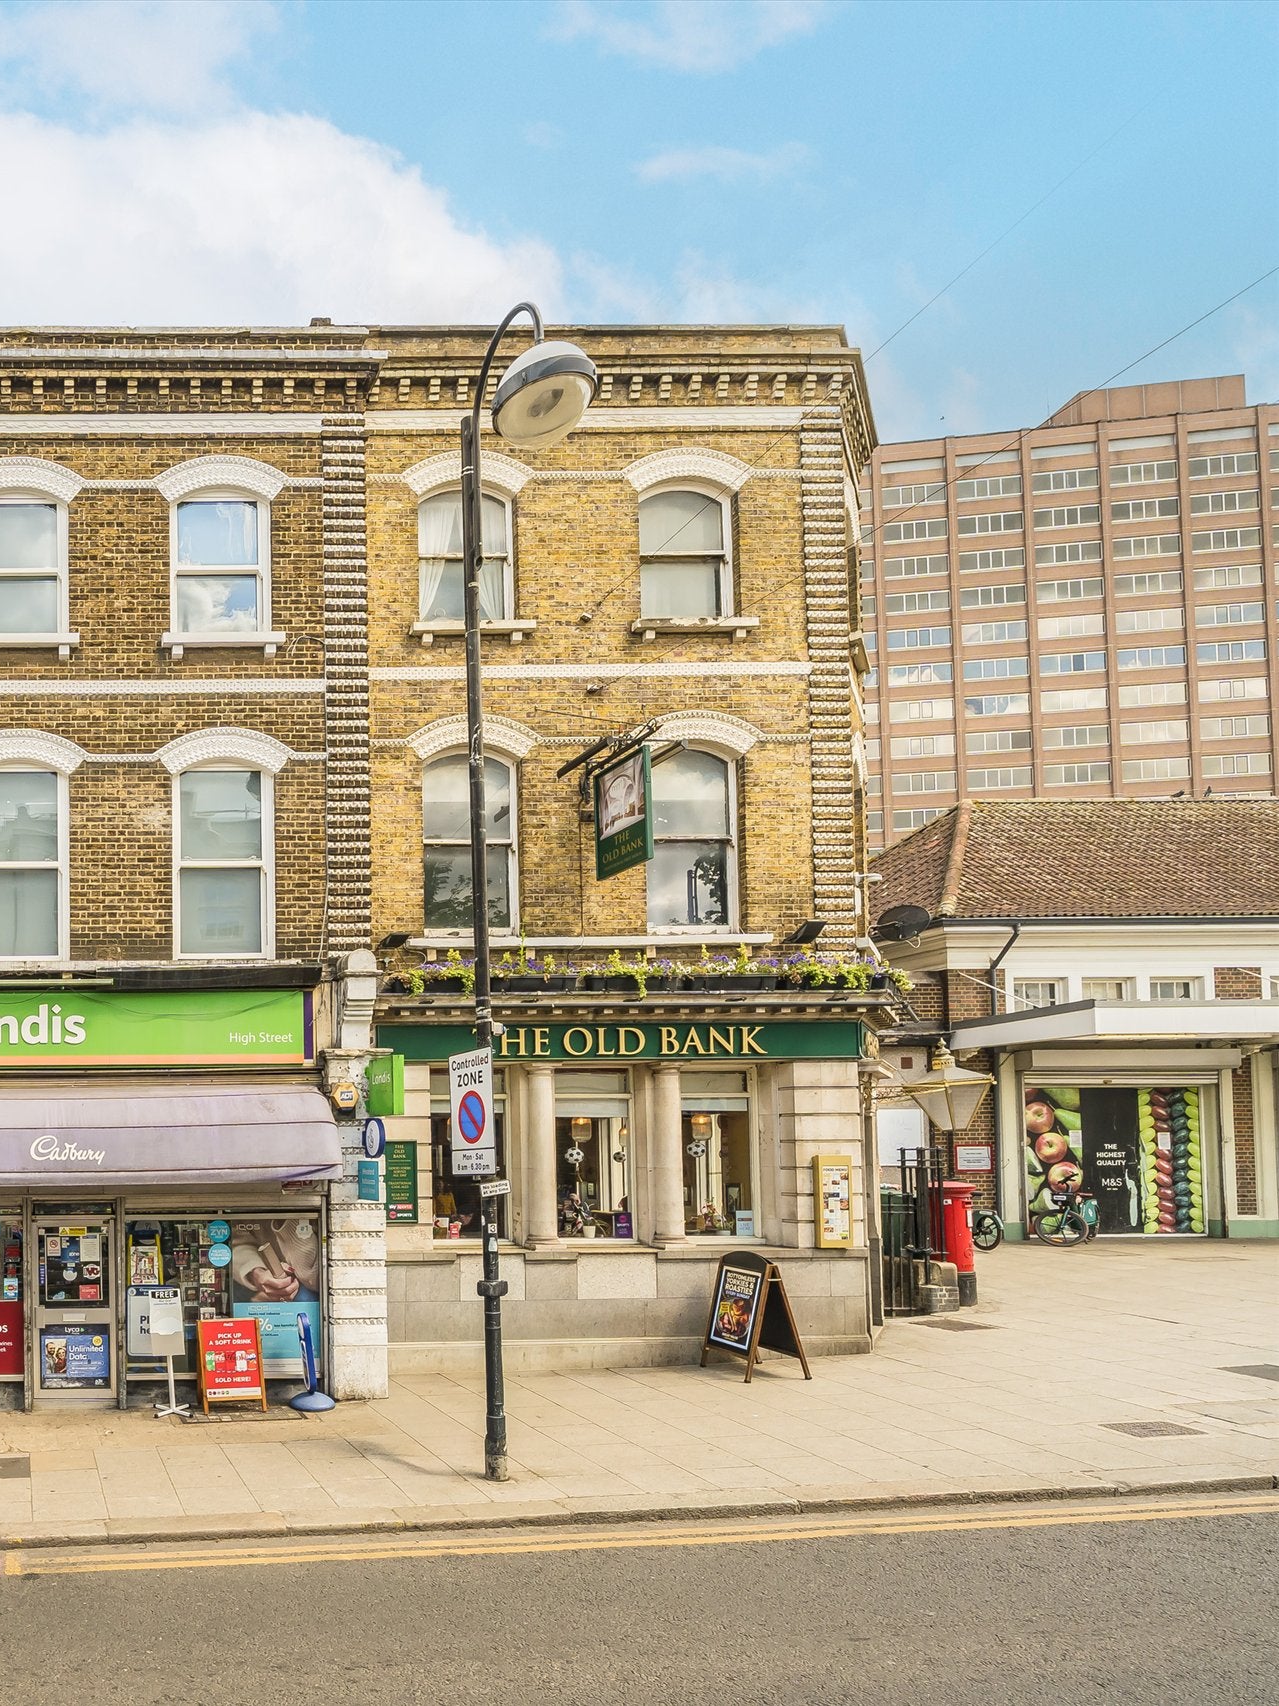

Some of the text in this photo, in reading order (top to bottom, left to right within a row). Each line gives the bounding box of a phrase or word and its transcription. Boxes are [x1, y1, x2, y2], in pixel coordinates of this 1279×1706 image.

[614, 830, 629, 845] THE
[603, 849, 619, 863] OLD
[621, 837, 644, 855] BANK
[229, 1031, 293, 1045] High Street
[472, 1026, 768, 1056] HE OLD BANK
[452, 1053, 489, 1071] Controlled
[372, 1071, 390, 1085] Londis
[457, 1070, 483, 1087] ZONE
[340, 1092, 353, 1100] ADT
[30, 1135, 106, 1165] Cadbury
[1102, 1178, 1123, 1187] M&S
[236, 1223, 260, 1231] IQOS
[490, 1225, 496, 1233] 3
[727, 1272, 755, 1283] BOTTOMLESS
[727, 1278, 749, 1287] YORKIES
[725, 1284, 753, 1295] ROASTIES
